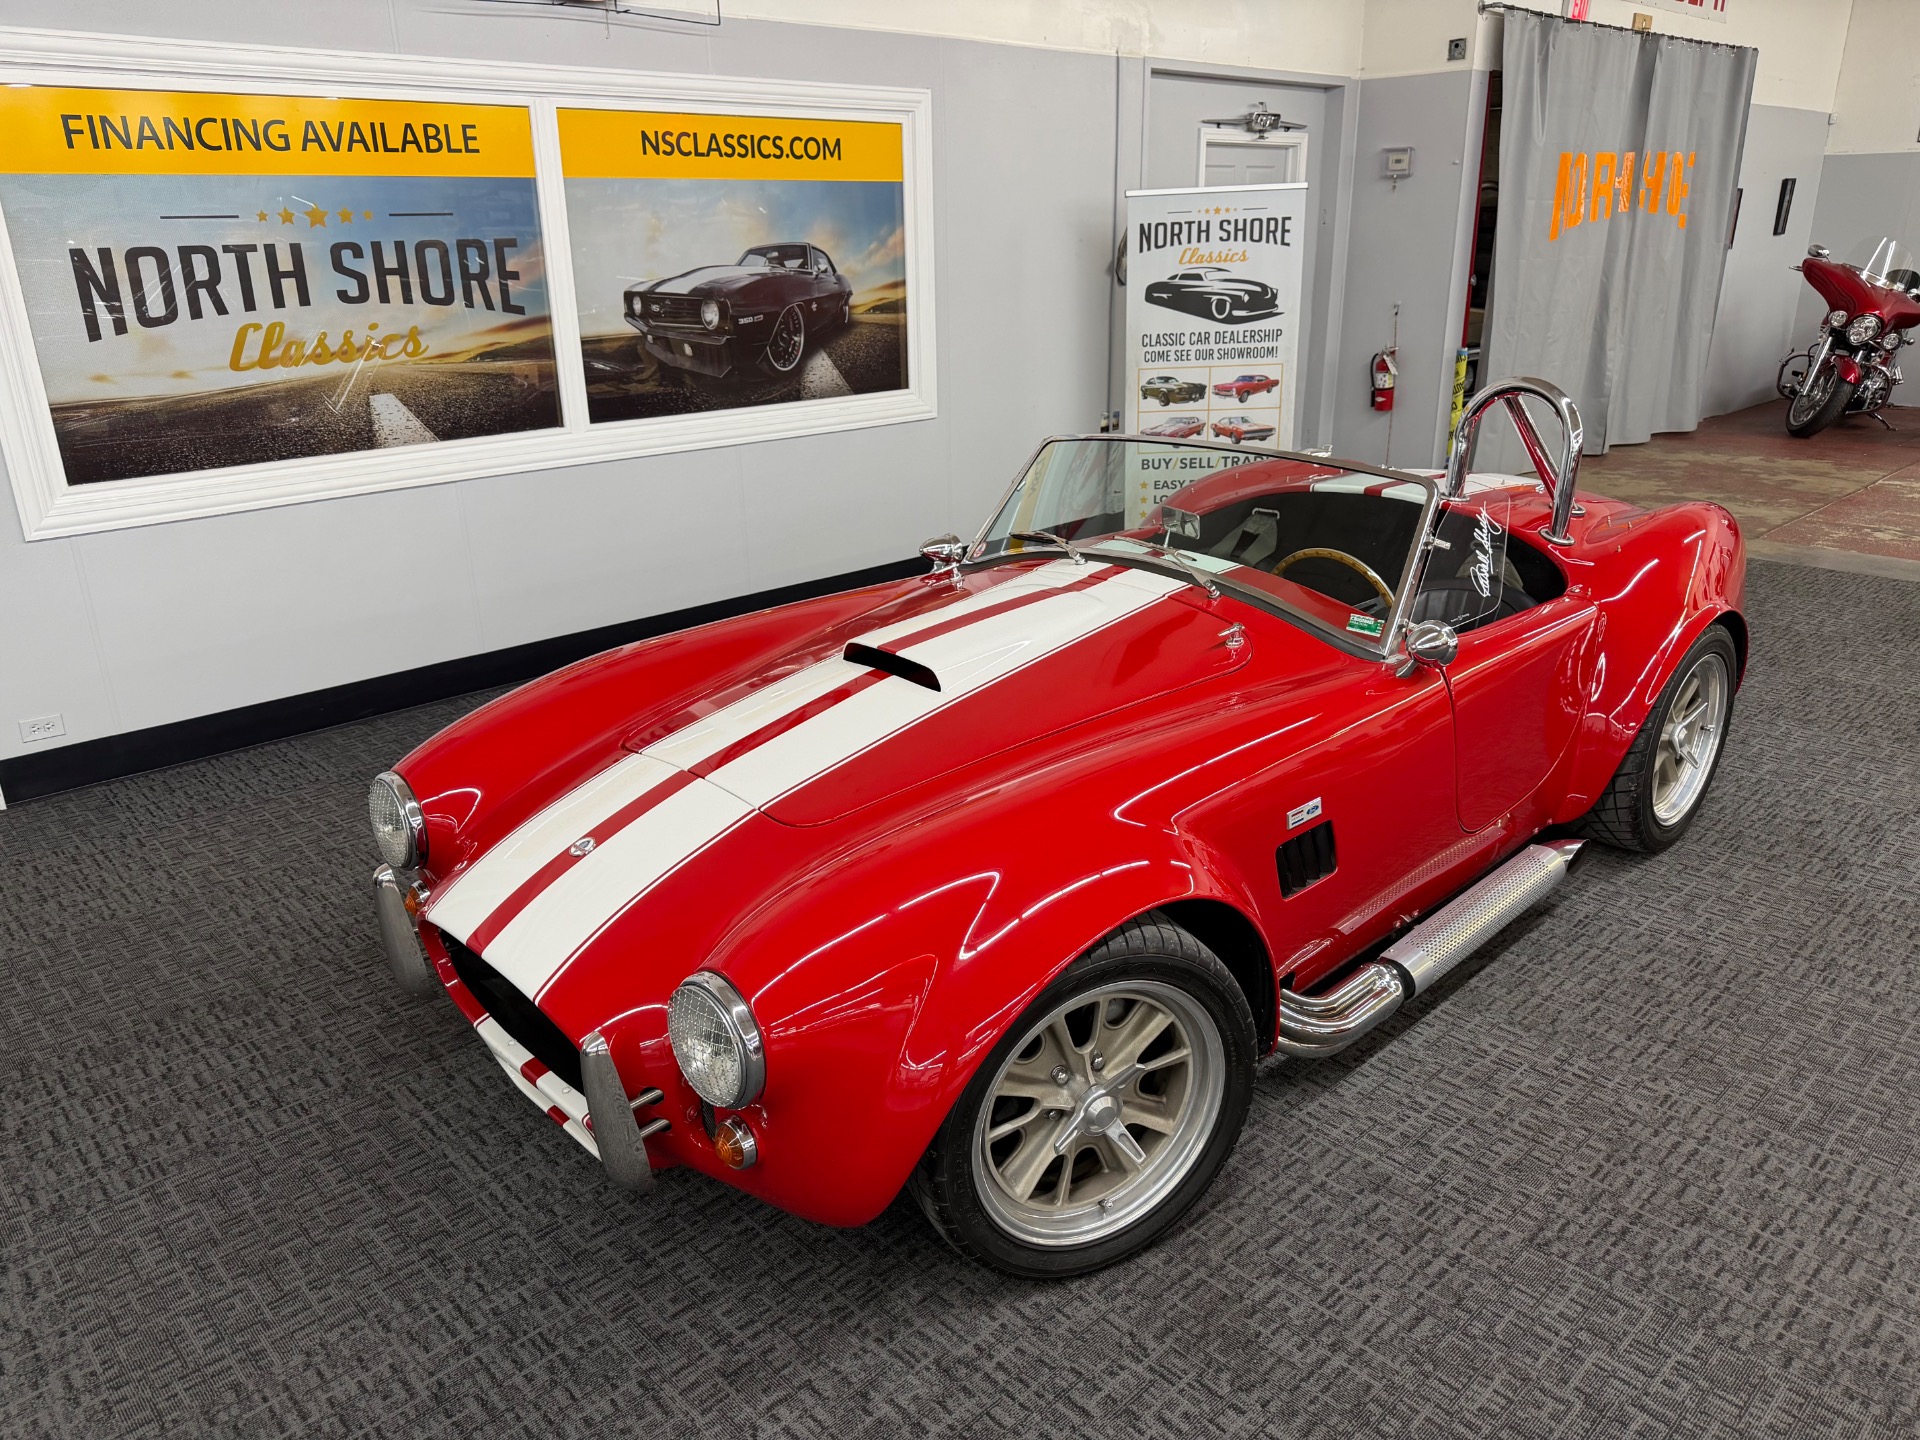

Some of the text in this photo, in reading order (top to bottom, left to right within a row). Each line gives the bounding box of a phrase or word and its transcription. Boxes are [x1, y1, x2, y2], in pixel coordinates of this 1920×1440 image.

[60, 113, 481, 155] FINANCING AVAILABLE
[639, 129, 843, 161] NSCLASSICS.COM
[1138, 215, 1292, 254] NORTH SHORE
[1178, 247, 1250, 266] Classics
[67, 237, 527, 343] NORTH SHORE
[229, 320, 431, 373] Classics
[1141, 328, 1283, 348] CLASSIC CAR DEALERSHIP
[1143, 346, 1279, 363] COME SEE OUR SHOWROOM!
[1153, 479, 1187, 491] EASY
